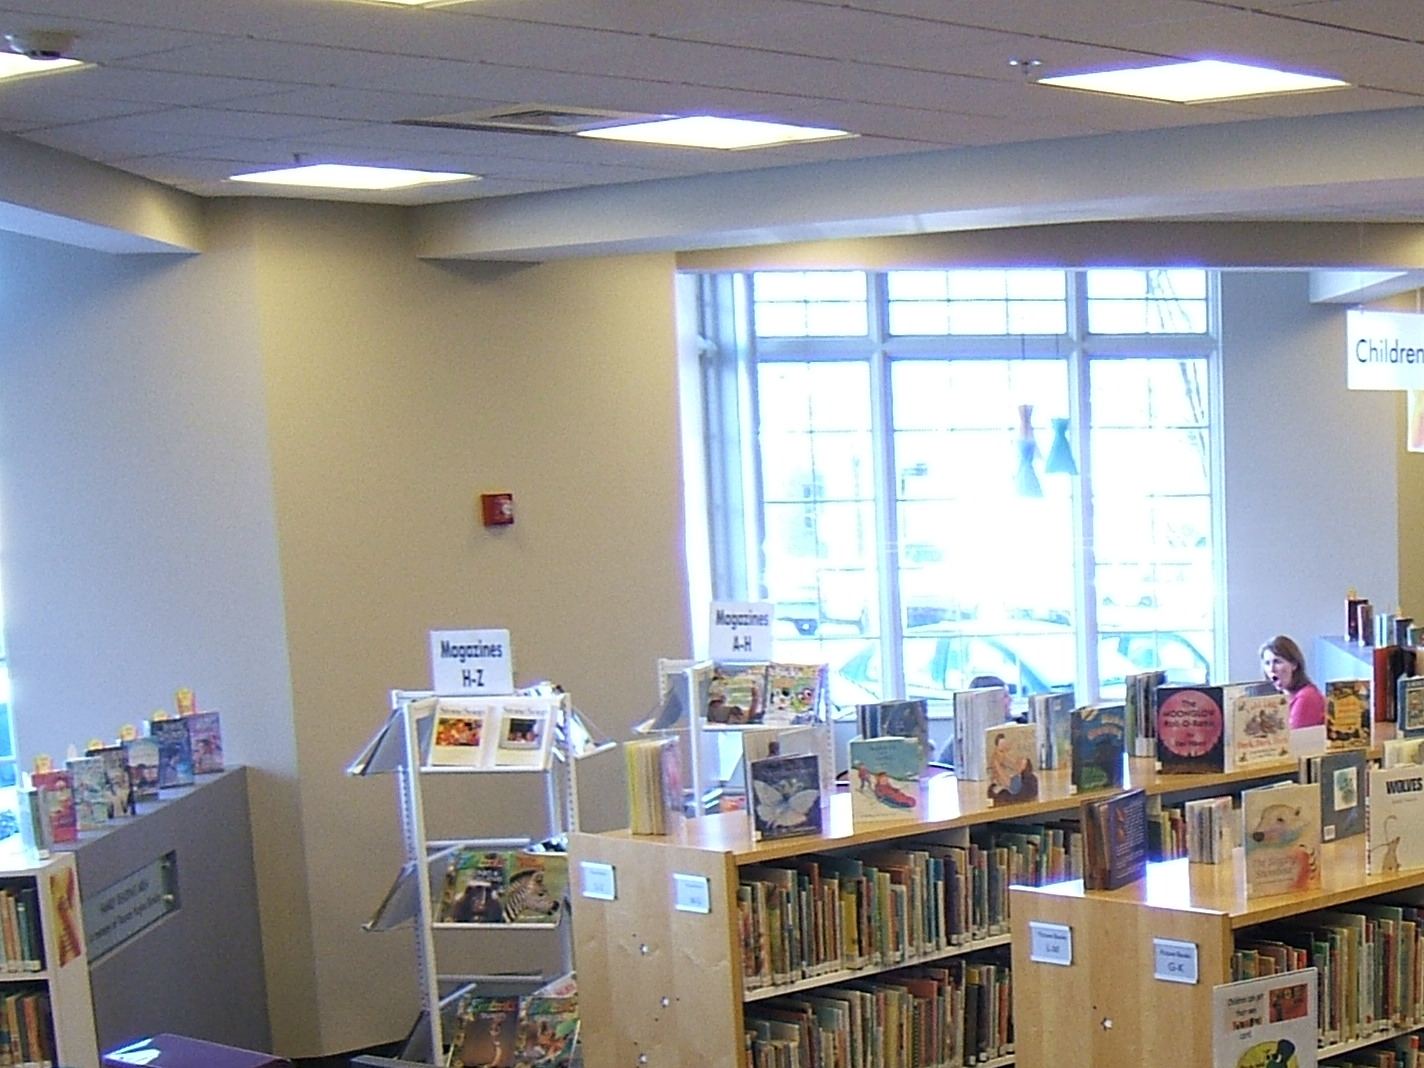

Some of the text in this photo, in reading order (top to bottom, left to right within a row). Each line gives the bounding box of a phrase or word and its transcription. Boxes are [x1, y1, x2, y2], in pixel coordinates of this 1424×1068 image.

[715, 608, 769, 630] Magazines
[440, 639, 503, 662] Magazines
[732, 635, 752, 652] A-H
[462, 668, 485, 688] H-Z
[1386, 777, 1423, 795] WOLVES
[1168, 962, 1184, 973] G-K
